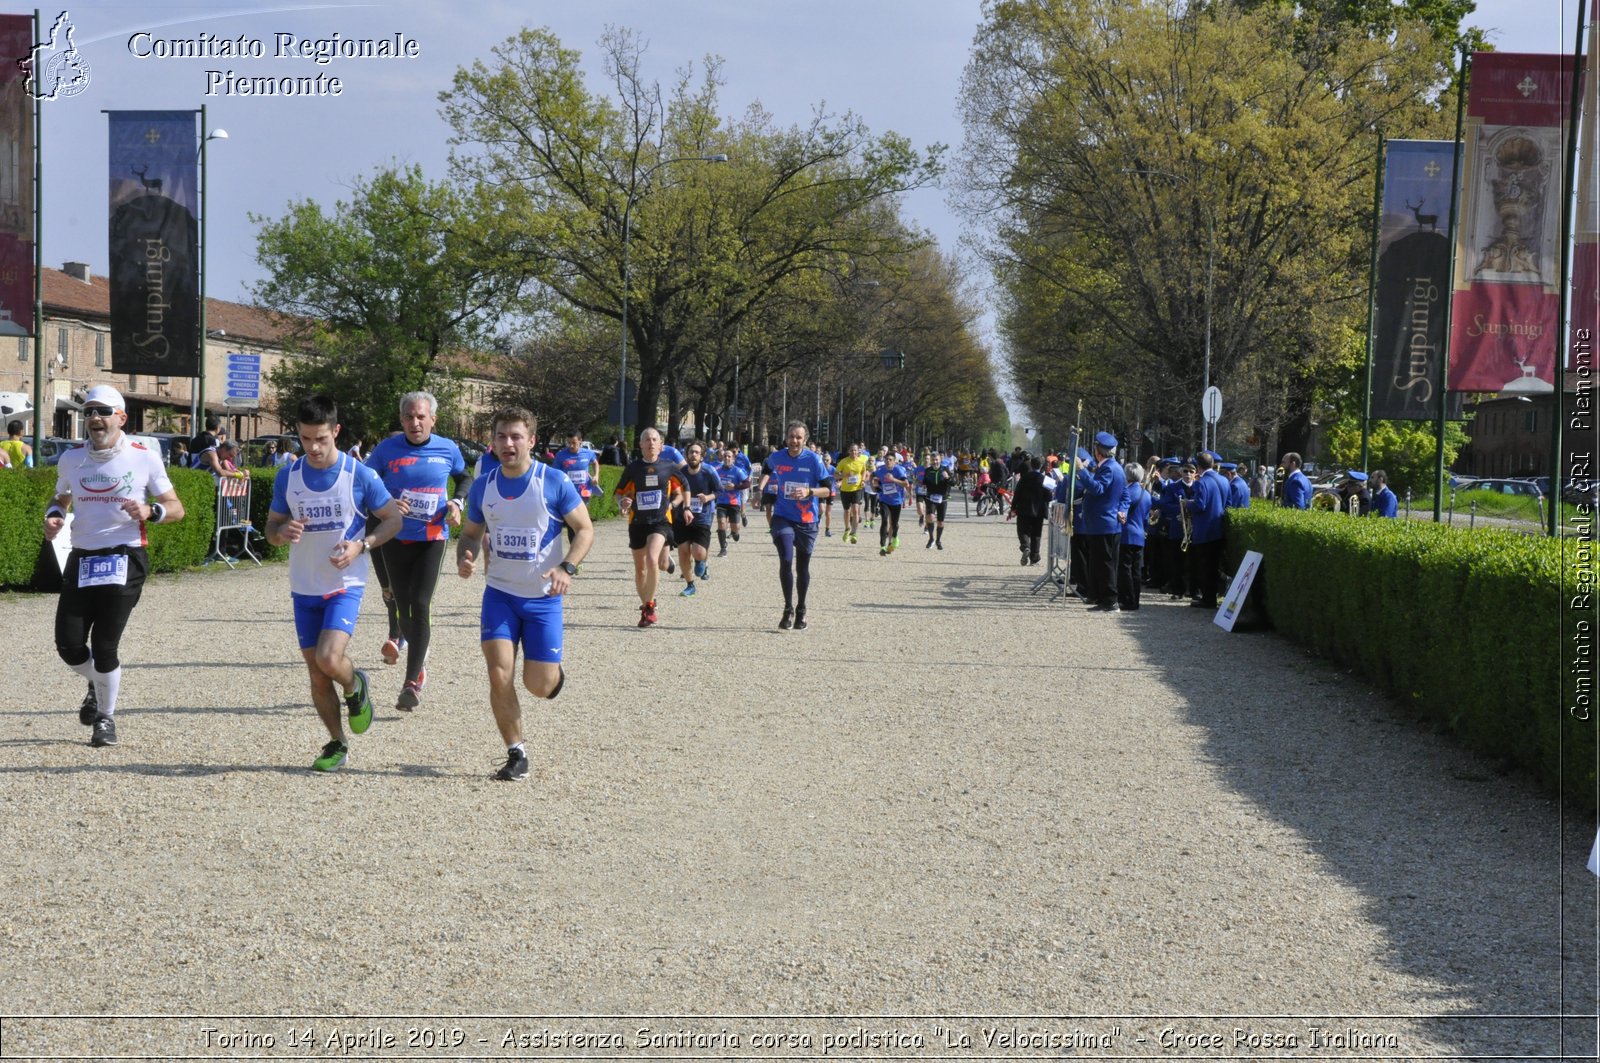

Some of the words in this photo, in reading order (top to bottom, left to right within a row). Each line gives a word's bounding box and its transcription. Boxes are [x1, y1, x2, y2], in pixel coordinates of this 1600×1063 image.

[132, 238, 171, 359] Stupinigi
[1466, 314, 1544, 340] Stupinigi
[1394, 277, 1438, 402] Stupinigi
[78, 495, 109, 504] running
[408, 498, 430, 510] 2350
[306, 506, 332, 518] 3378
[503, 535, 527, 547] 3374
[93, 561, 112, 573] 561
